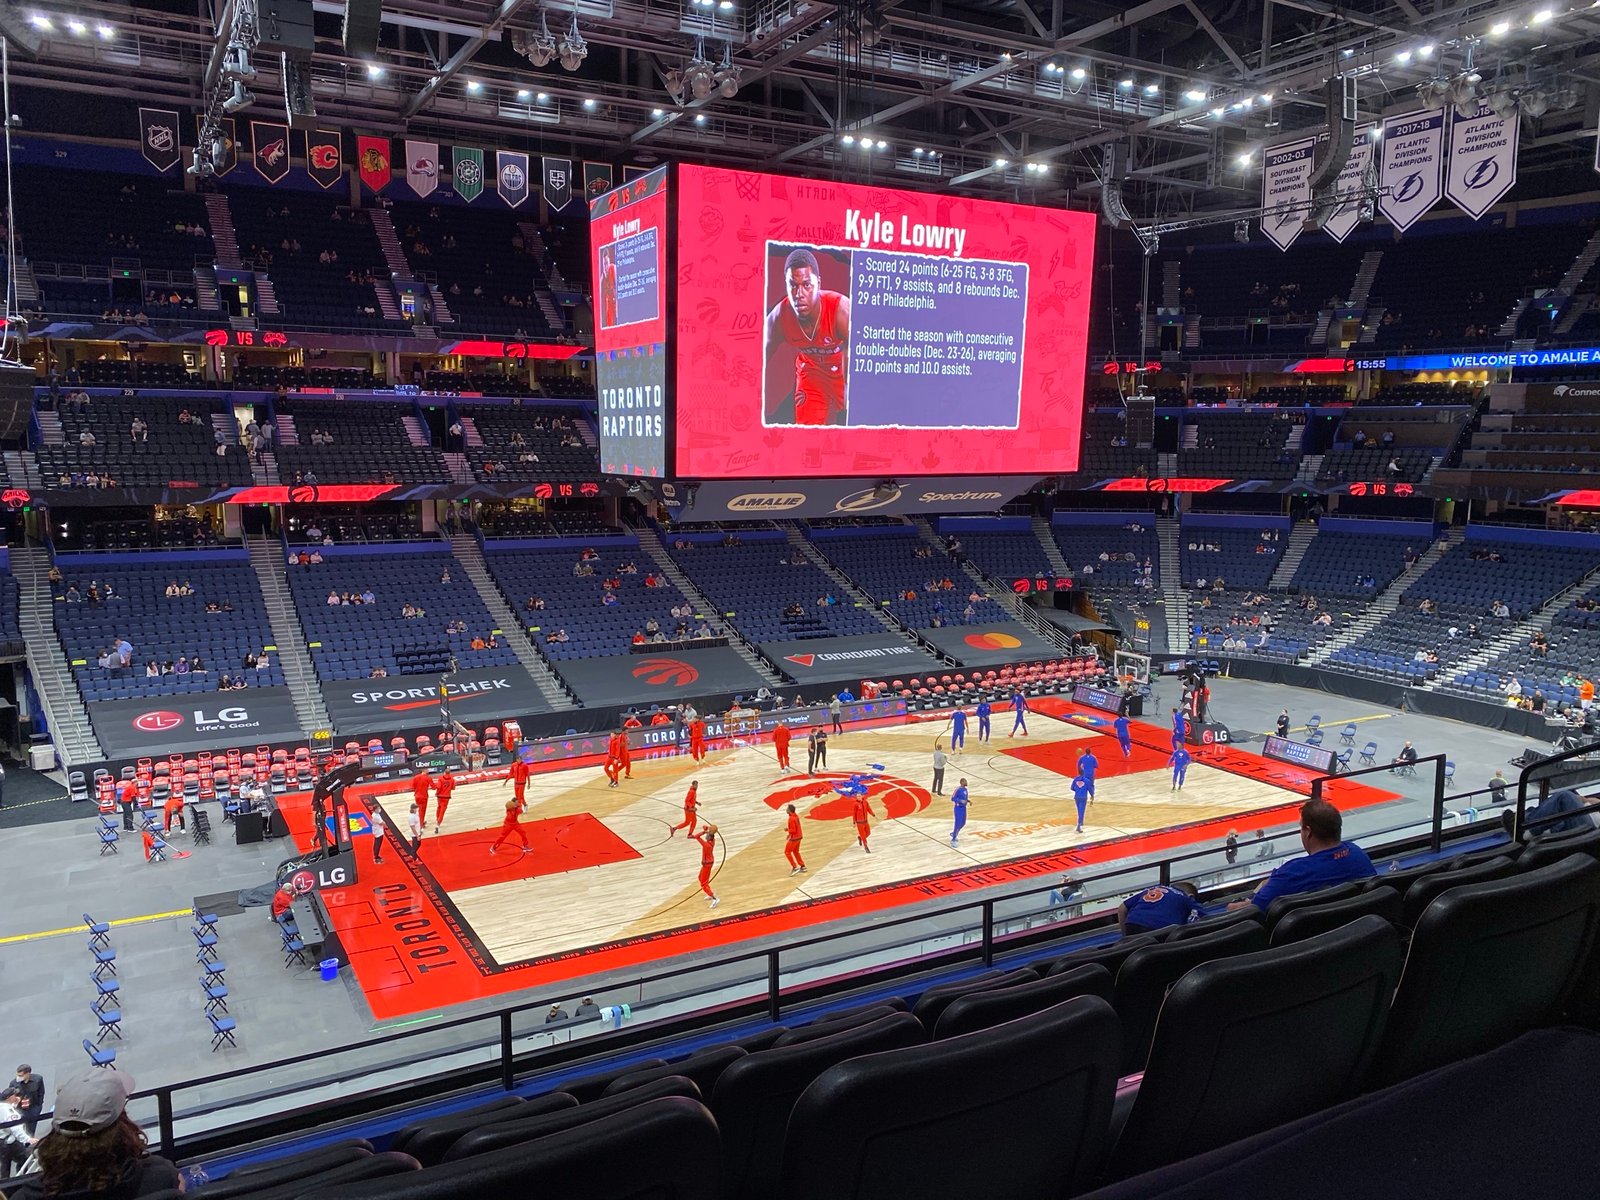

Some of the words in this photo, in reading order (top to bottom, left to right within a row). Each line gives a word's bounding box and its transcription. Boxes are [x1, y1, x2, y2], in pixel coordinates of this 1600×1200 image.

[1396, 120, 1430, 136] 2017-18
[1464, 120, 1504, 135] ATLANTIC
[153, 132, 169, 146] NHL
[1394, 137, 1430, 150] ATLANTIC
[1465, 130, 1502, 144] DIVISION
[1395, 147, 1427, 160] DIVISION
[1458, 138, 1507, 155] CHAMPIONS
[1272, 149, 1306, 165] 2002-03
[1388, 155, 1433, 170] CHAMPIONS
[1269, 165, 1307, 179] SOUTHEAST
[1274, 174, 1301, 186] DIVISION
[1269, 182, 1306, 195] CHAMPIONS
[613, 221, 625, 241] Kyle
[625, 218, 640, 236] Lowry
[845, 209, 894, 248] Kyle
[901, 215, 966, 257] Lowry
[866, 257, 897, 273] Scored
[899, 260, 910, 274] 24
[912, 263, 939, 280] points
[965, 267, 978, 281] FG,
[980, 267, 995, 281] 3-8
[997, 269, 1014, 284] 3FG,
[858, 274, 874, 288] 9-9
[895, 277, 901, 291] 9
[903, 278, 935, 295] assists,
[938, 281, 953, 294] and
[956, 282, 961, 295] 8
[963, 282, 1001, 297] rebounds
[1003, 286, 1020, 299] Dec.
[858, 291, 869, 305] 29
[871, 293, 881, 306] at
[883, 294, 937, 310] Philadelphia.
[236, 331, 253, 345] VS
[863, 325, 896, 340] Started
[898, 327, 912, 341] the
[914, 330, 944, 343] season
[945, 330, 964, 344] with
[966, 333, 1014, 346] consecutive
[856, 342, 921, 358] double-doubles
[978, 349, 1017, 364] averaging
[1452, 354, 1517, 368] WELCOME
[1521, 354, 1538, 365] TO
[1543, 352, 1589, 364] AMALIE
[855, 359, 873, 373] 17.0
[875, 361, 901, 375] points
[903, 362, 920, 374] and
[921, 362, 940, 374] 10.0
[941, 363, 973, 376] assists.
[1126, 363, 1137, 373] VS
[1355, 359, 1386, 370] 15:55
[123, 388, 135, 396] 229
[602, 384, 662, 410] TORONTO
[603, 414, 662, 437] RAPTORS
[723, 450, 760, 468] Tampa
[560, 484, 572, 496] VS
[919, 491, 1002, 502] Spectrum
[1374, 484, 1386, 495] VS
[732, 497, 802, 507] AMALIE
[1036, 580, 1048, 591] VS
[817, 649, 885, 662] CANADIAN
[886, 645, 914, 656] TIRE
[351, 686, 437, 704] SPORT
[446, 678, 513, 695] CHEK
[194, 707, 249, 725] LG
[195, 724, 226, 732] Life's
[229, 721, 260, 730] Good
[1214, 730, 1228, 743] LG
[319, 867, 346, 887] LG
[915, 882, 953, 896] WE
[951, 871, 1005, 888] THE
[1003, 854, 1089, 877] NORTH
[373, 883, 458, 974] TORONTO
